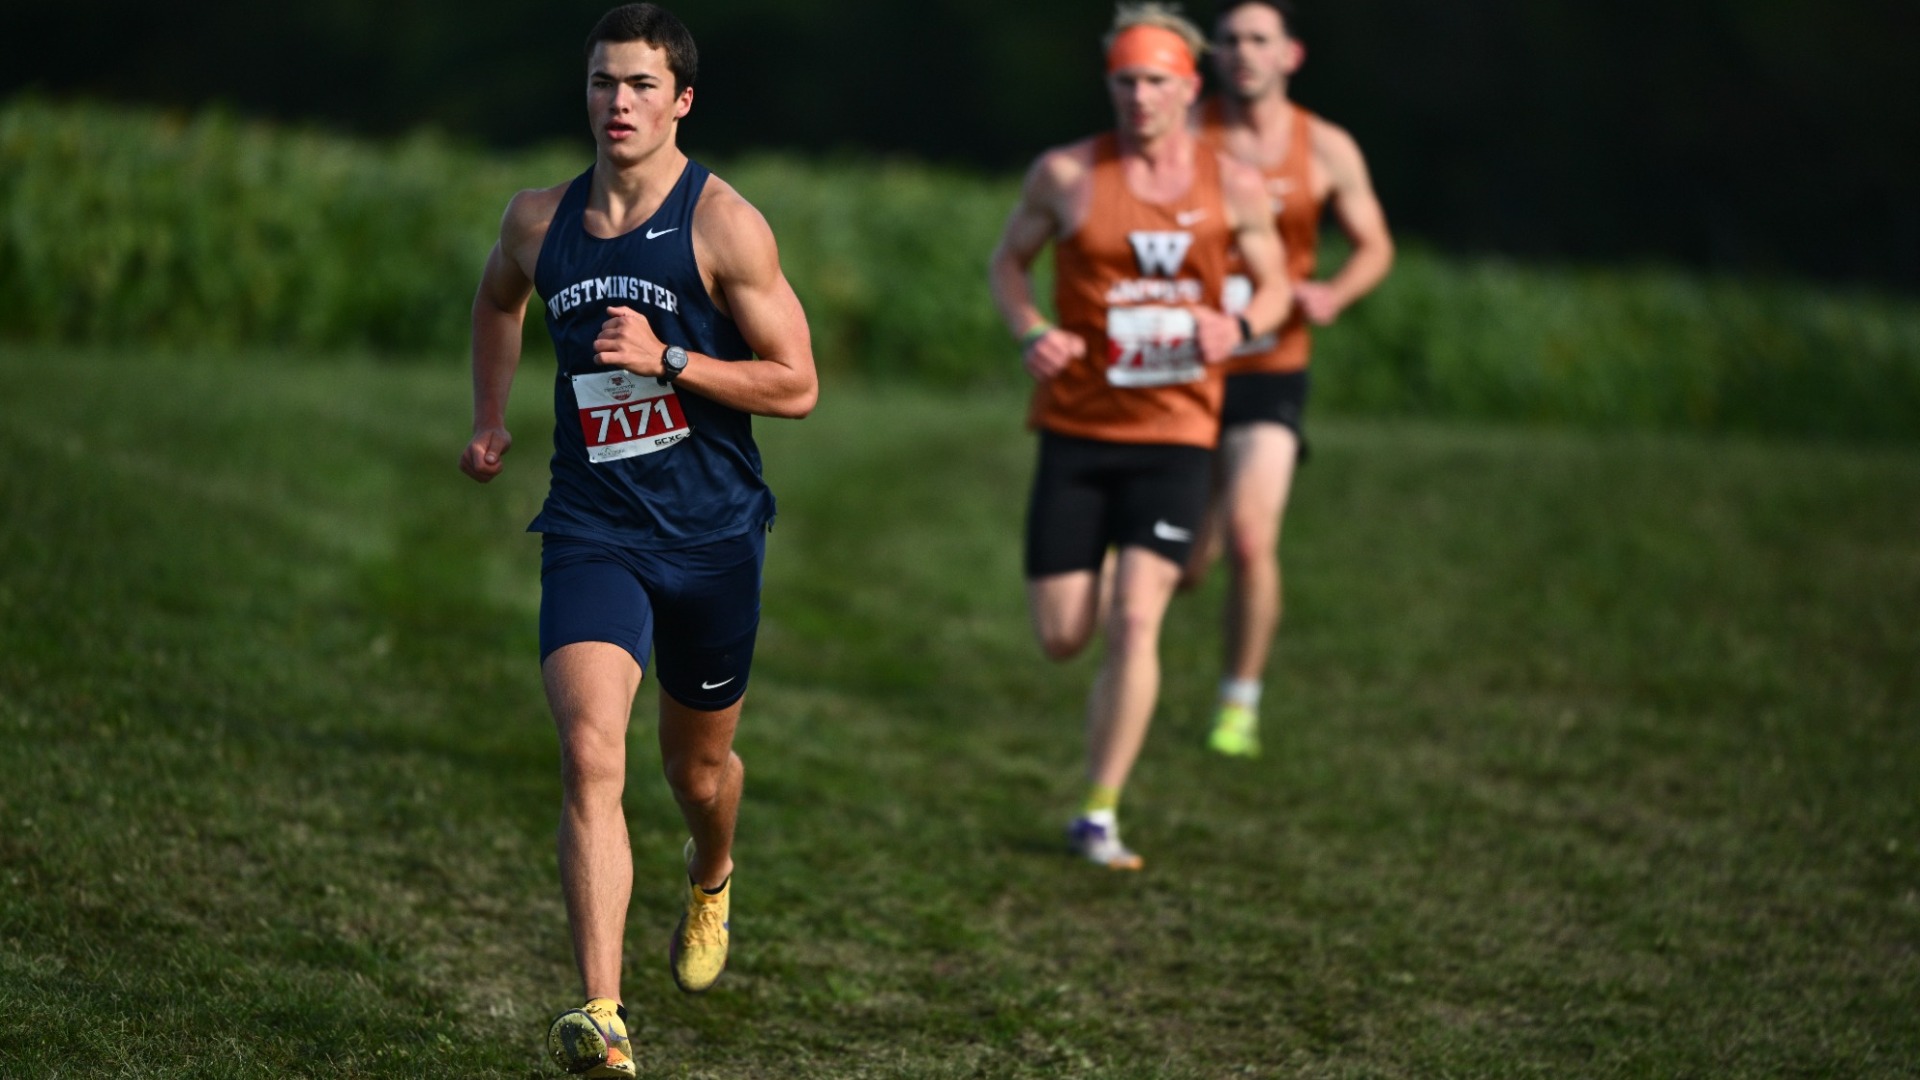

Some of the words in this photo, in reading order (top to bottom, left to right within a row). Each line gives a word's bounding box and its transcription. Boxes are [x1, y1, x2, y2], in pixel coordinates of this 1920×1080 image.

[1128, 231, 1194, 277] W
[548, 276, 679, 319] WESTMINSTER
[590, 398, 674, 443] 7171
[654, 433, 682, 446] GCXC
